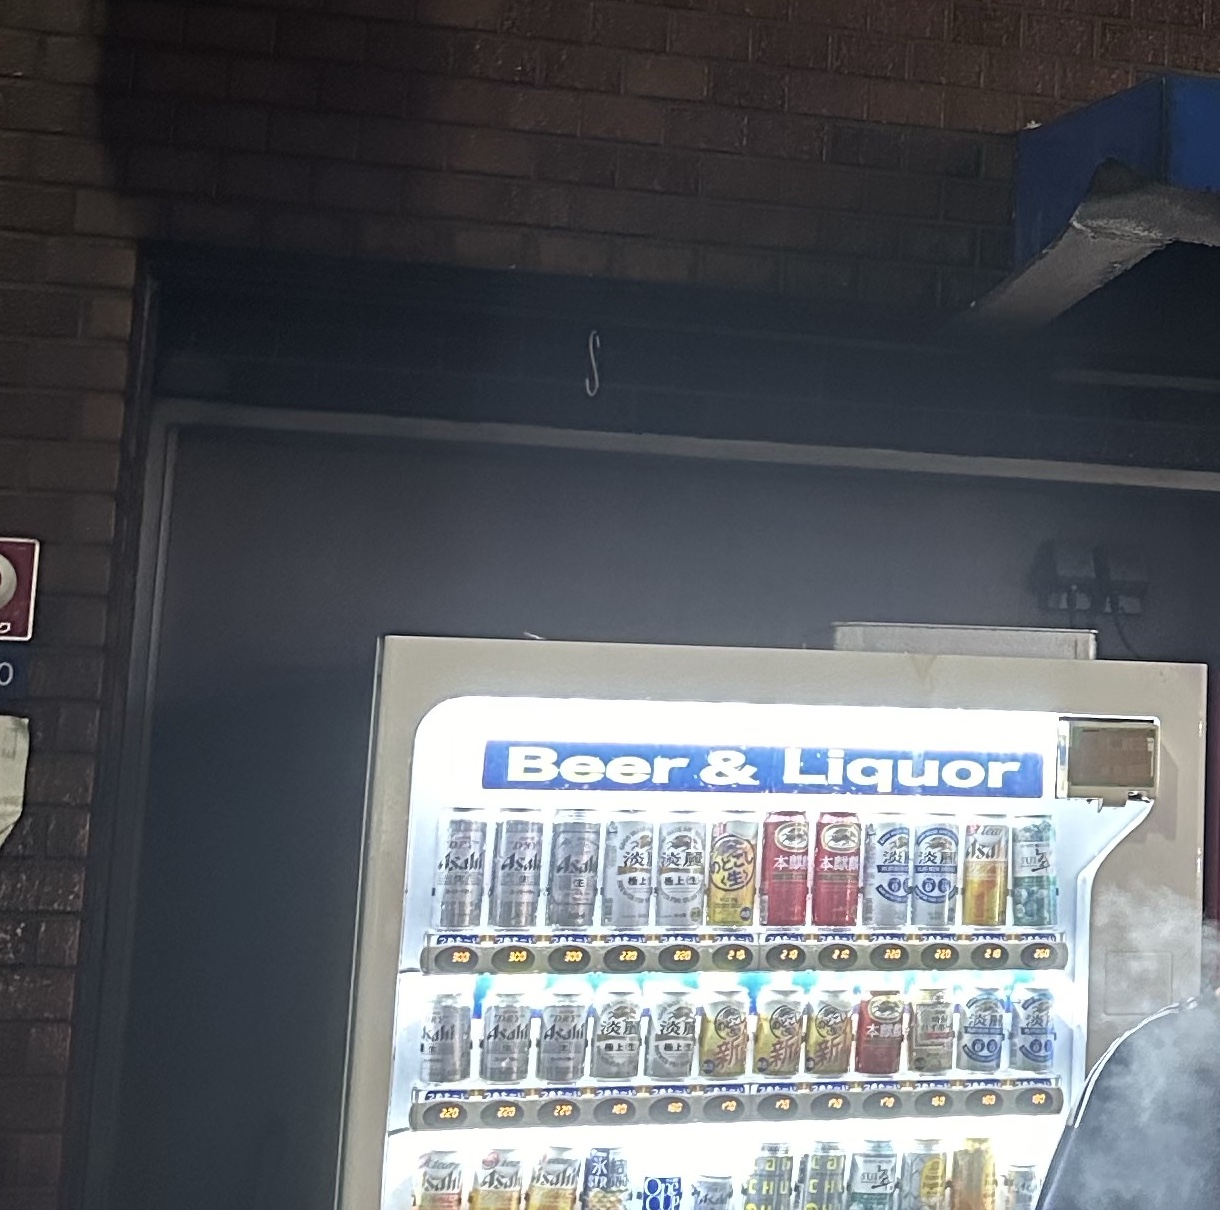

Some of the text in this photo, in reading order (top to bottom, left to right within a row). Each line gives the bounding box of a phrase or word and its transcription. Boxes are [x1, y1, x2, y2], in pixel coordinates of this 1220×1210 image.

[507, 745, 1021, 793] Beer & Liquor
